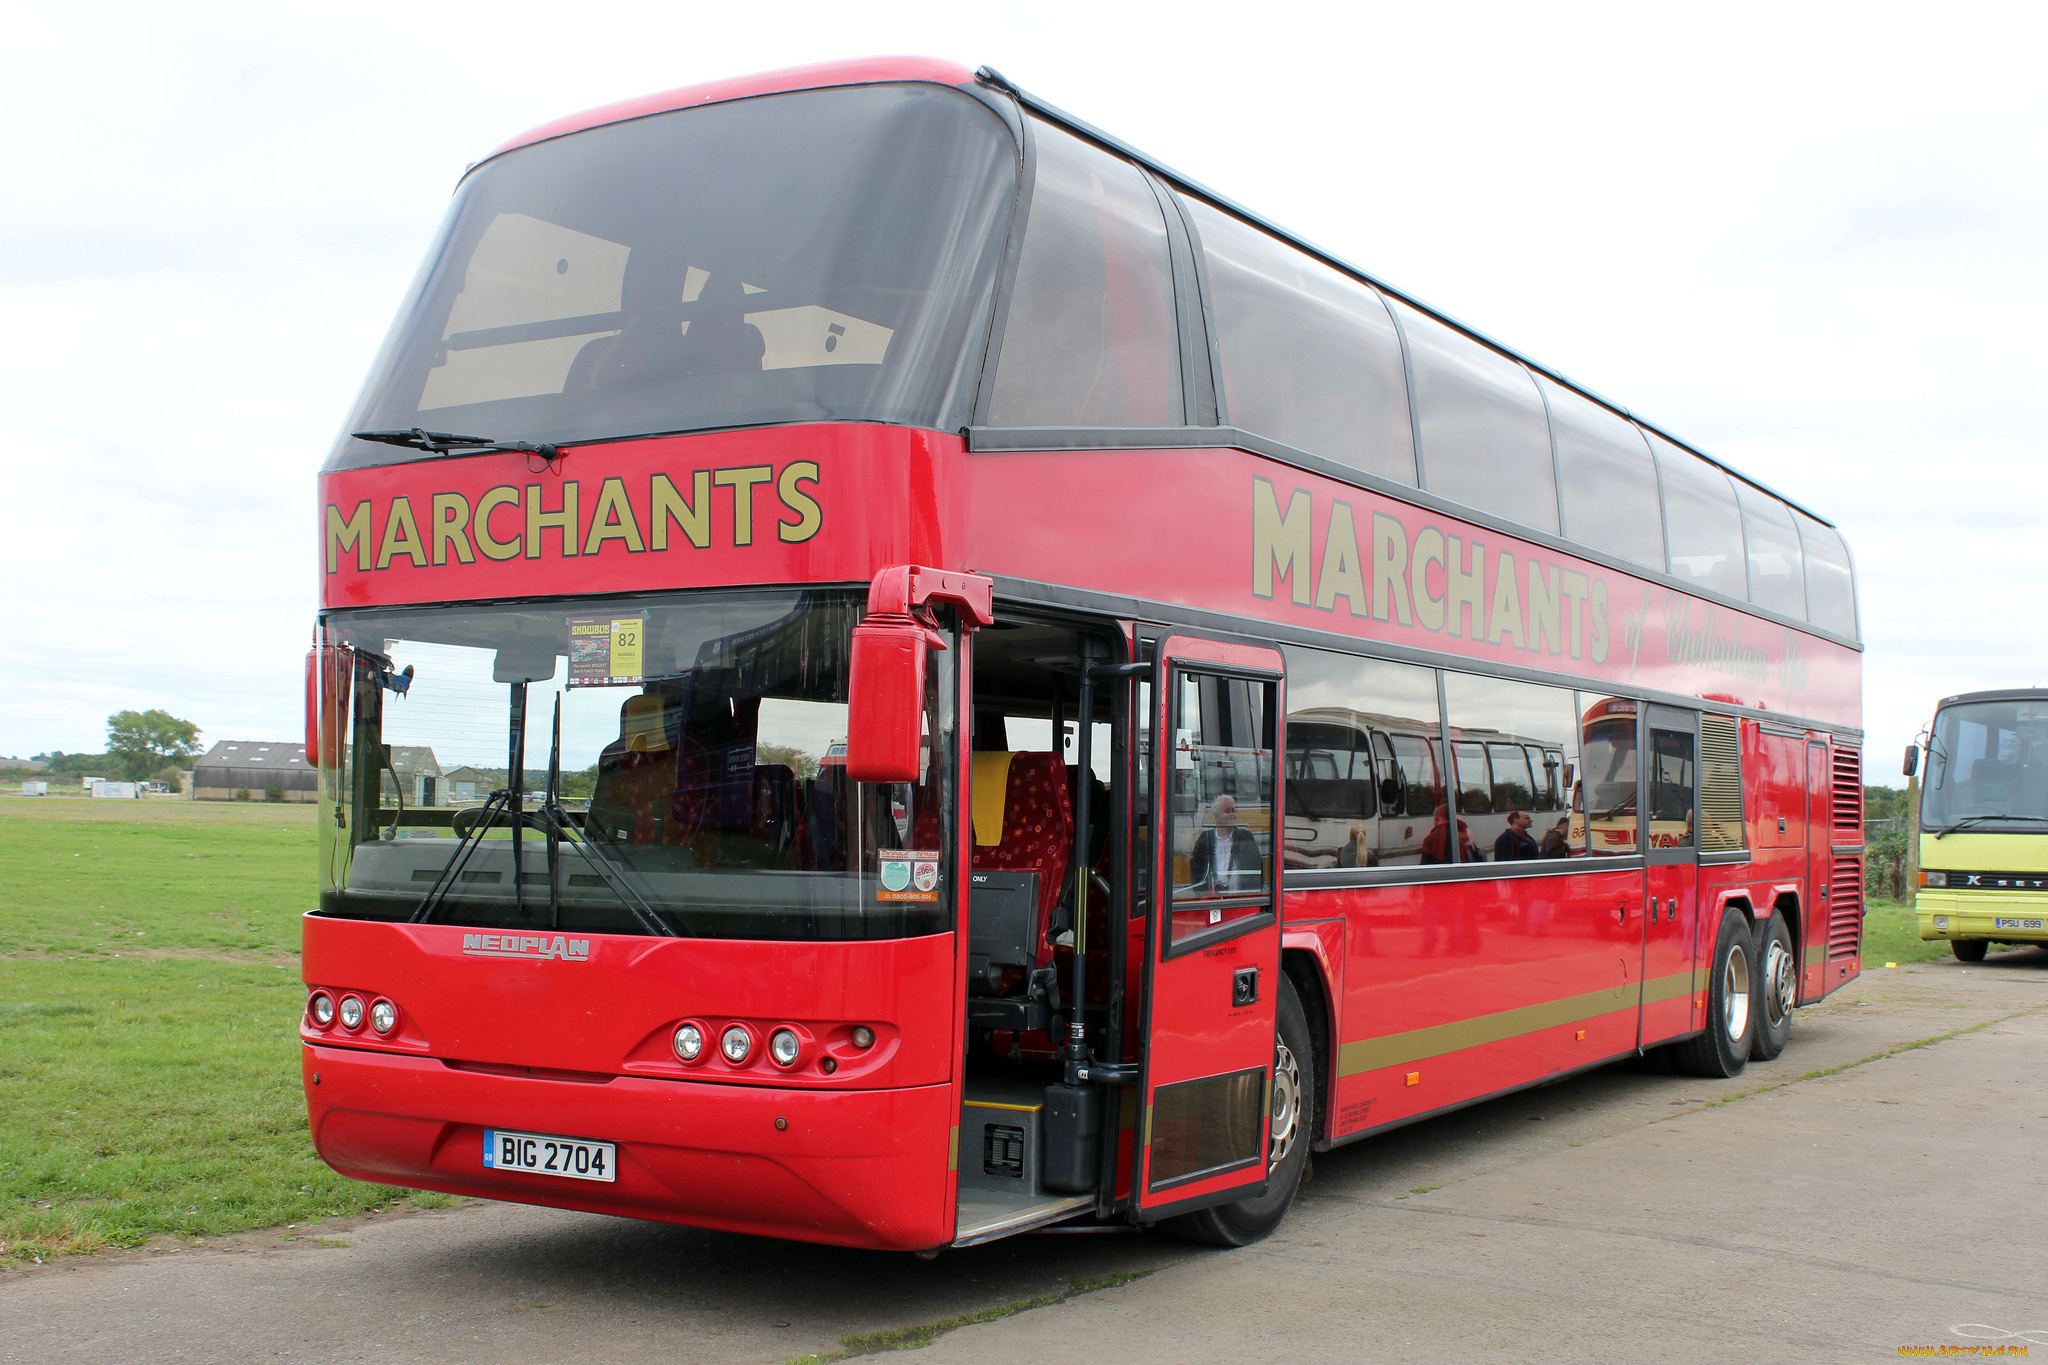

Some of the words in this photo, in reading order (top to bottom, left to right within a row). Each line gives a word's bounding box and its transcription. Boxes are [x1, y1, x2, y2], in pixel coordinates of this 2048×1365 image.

[326, 460, 823, 575] MARCHANTS
[1252, 474, 1610, 665] MARCHANTS
[1624, 584, 1650, 680] of
[572, 625, 610, 635] SHOWBUS
[618, 633, 636, 646] 82
[2001, 920, 2019, 928] PSU
[2023, 920, 2042, 928] 699
[463, 934, 589, 961] NEOPLAN
[1203, 948, 1227, 957] EMERGENCY
[1228, 947, 1237, 955] EXIT
[484, 1153, 493, 1161] GB
[501, 1137, 537, 1167] BIG
[544, 1142, 605, 1176] 2704
